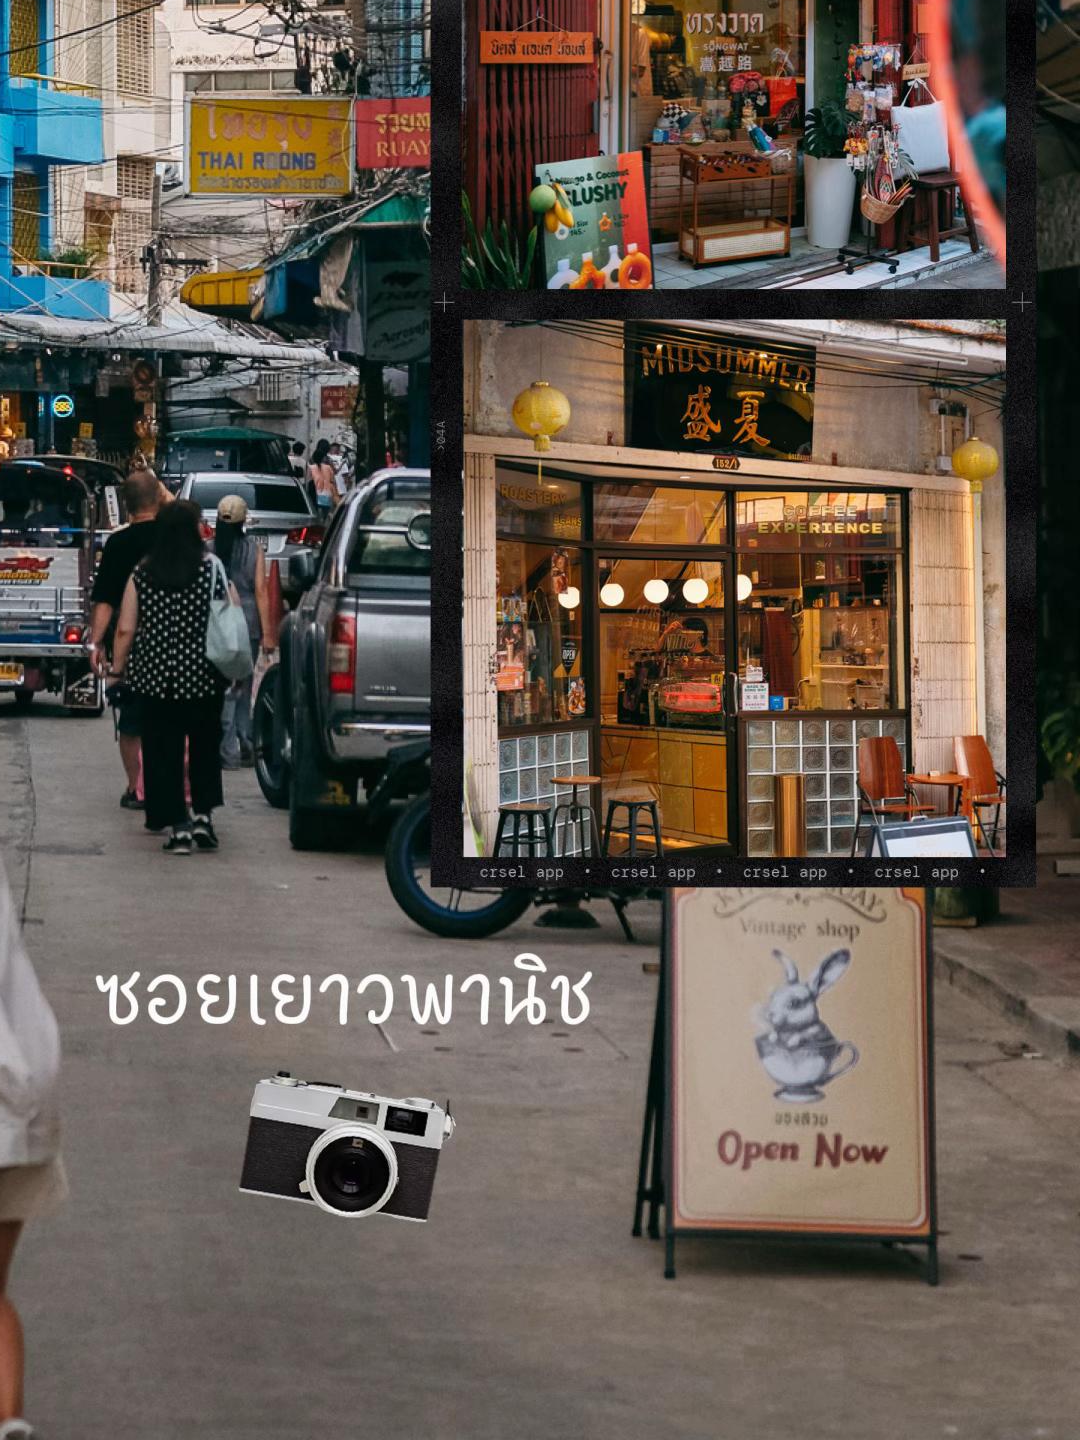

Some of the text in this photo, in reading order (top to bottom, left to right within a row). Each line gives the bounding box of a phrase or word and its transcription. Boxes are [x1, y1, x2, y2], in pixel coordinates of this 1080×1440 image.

[702, 41, 750, 52] SONGWAT
[198, 151, 243, 170] THAI
[641, 343, 812, 395] MIDSUMMER
[680, 384, 772, 447] 盛夏
[783, 504, 858, 518] COFFEE
[757, 522, 883, 534] EXPERIENCE
[740, 917, 861, 943] Vintage shop
[717, 1129, 889, 1171] Open Now
